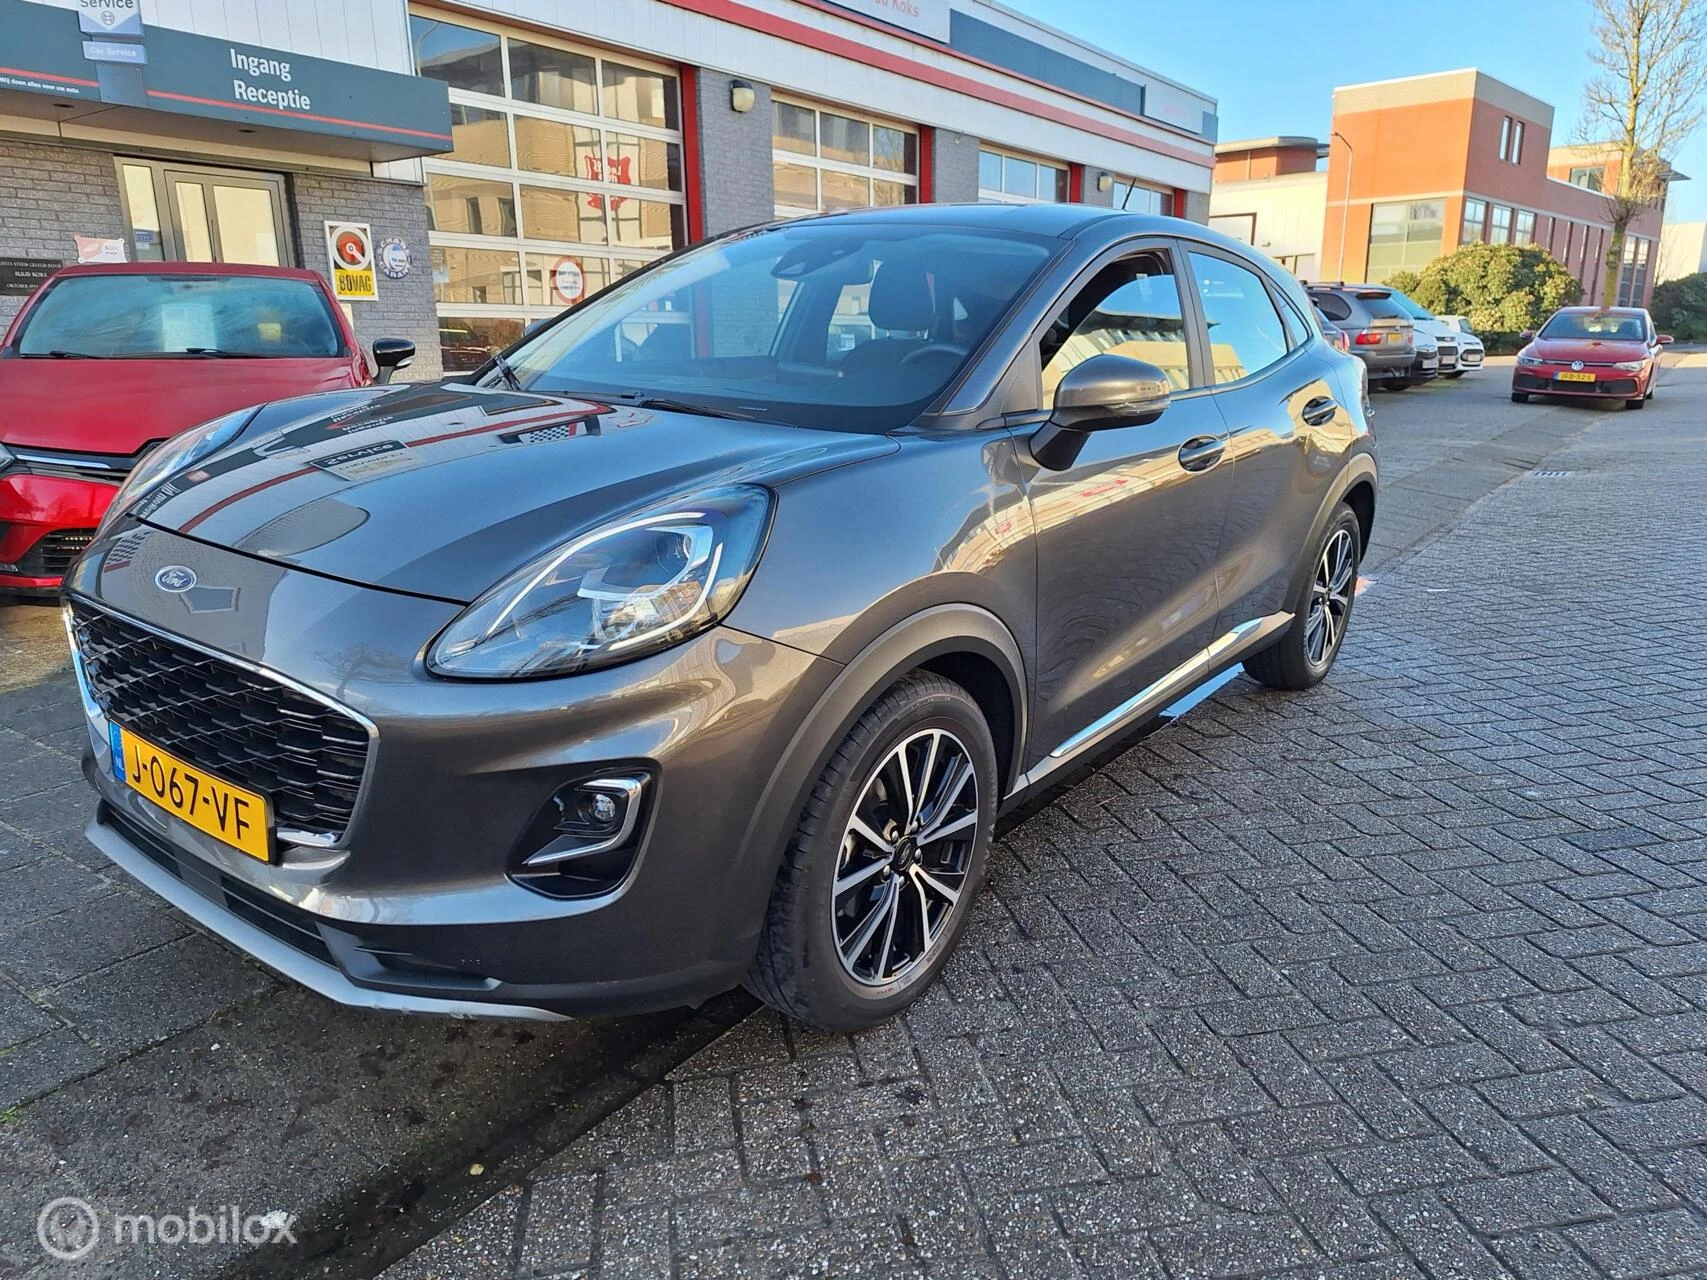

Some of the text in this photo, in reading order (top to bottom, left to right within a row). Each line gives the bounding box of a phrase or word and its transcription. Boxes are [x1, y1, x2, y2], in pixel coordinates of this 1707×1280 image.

[229, 47, 292, 82] Ingang
[233, 79, 311, 110] Receptie
[339, 274, 372, 293] BOVAG
[132, 744, 250, 841] J-067-VF
